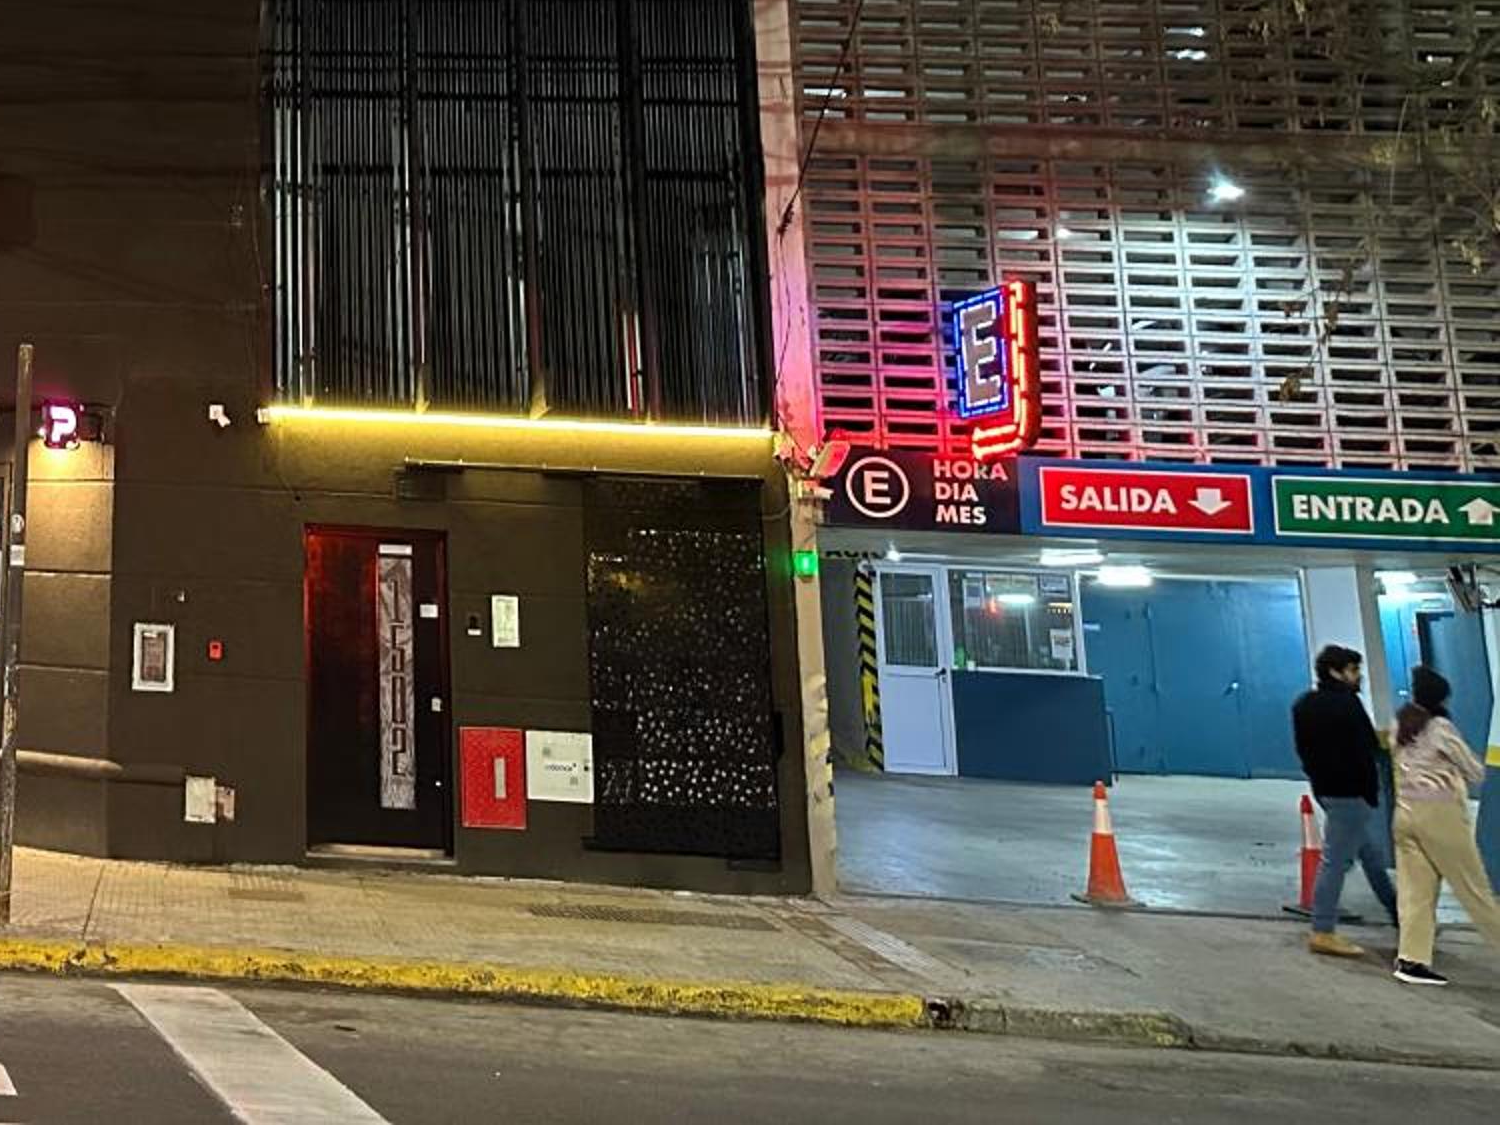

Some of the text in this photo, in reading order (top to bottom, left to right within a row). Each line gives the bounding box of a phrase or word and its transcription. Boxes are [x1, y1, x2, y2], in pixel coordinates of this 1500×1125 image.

[960, 300, 1002, 408] E
[933, 459, 1008, 480] HORA
[863, 470, 891, 504] E
[934, 482, 979, 502] DIA
[1060, 484, 1178, 514] SALIDA
[935, 505, 987, 524] MES
[1291, 494, 1450, 524] ENTRADA
